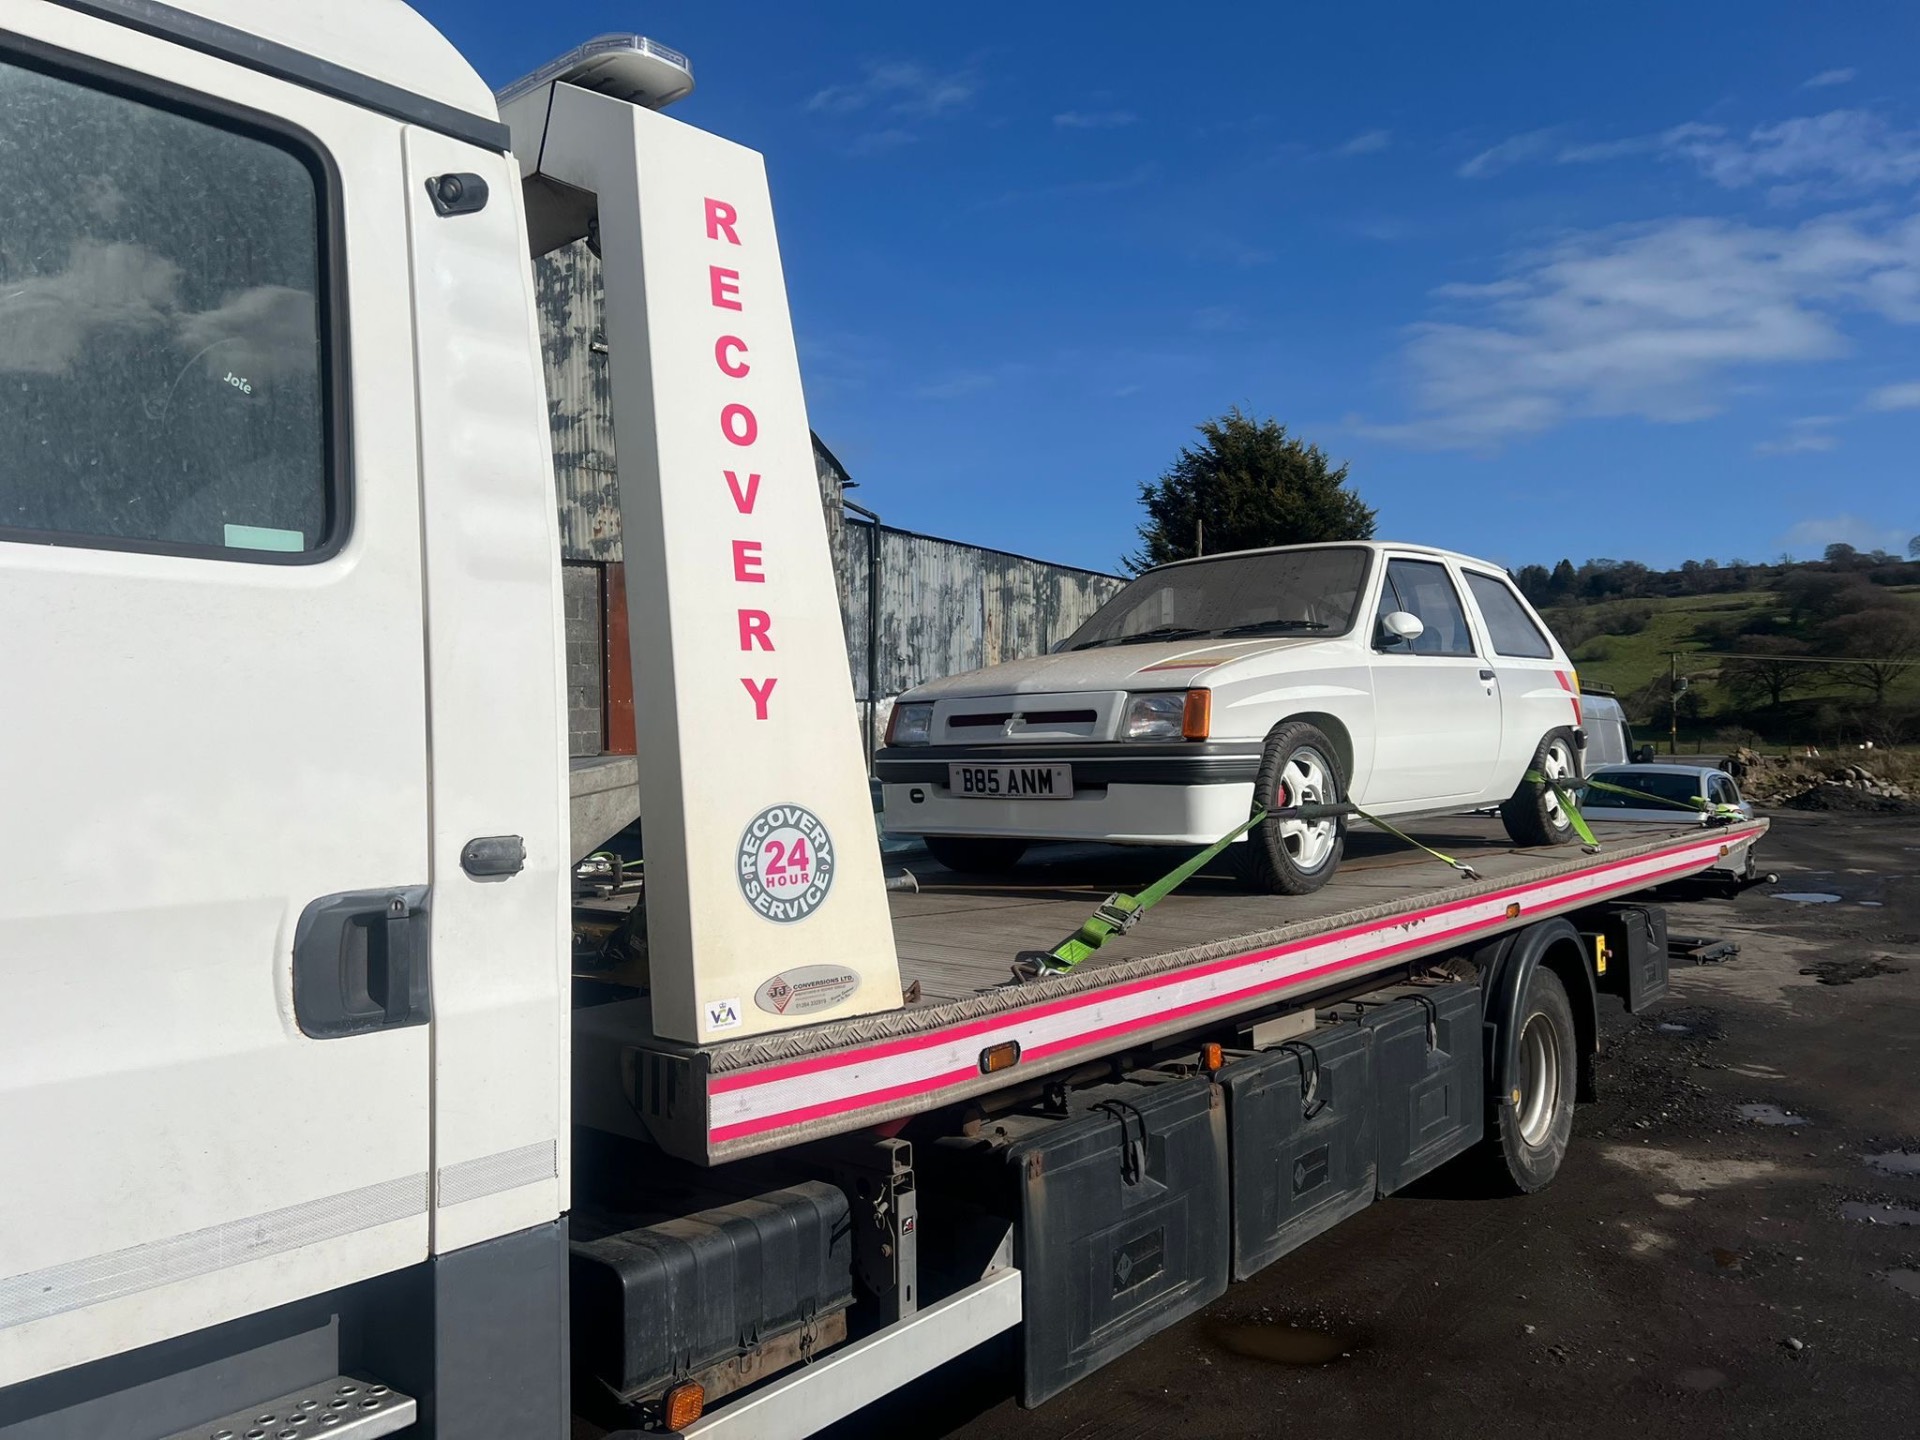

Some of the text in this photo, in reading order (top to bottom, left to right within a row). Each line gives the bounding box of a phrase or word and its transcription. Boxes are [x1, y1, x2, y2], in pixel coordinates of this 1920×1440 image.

[704, 197, 778, 720] RECOVERY
[962, 768, 1053, 794] B85 ANM
[741, 808, 832, 874] RECOVERY
[764, 838, 809, 875] 24
[745, 872, 829, 919] SERVICE
[766, 873, 810, 888] HOUR
[793, 977, 839, 990] CONVERSIONS
